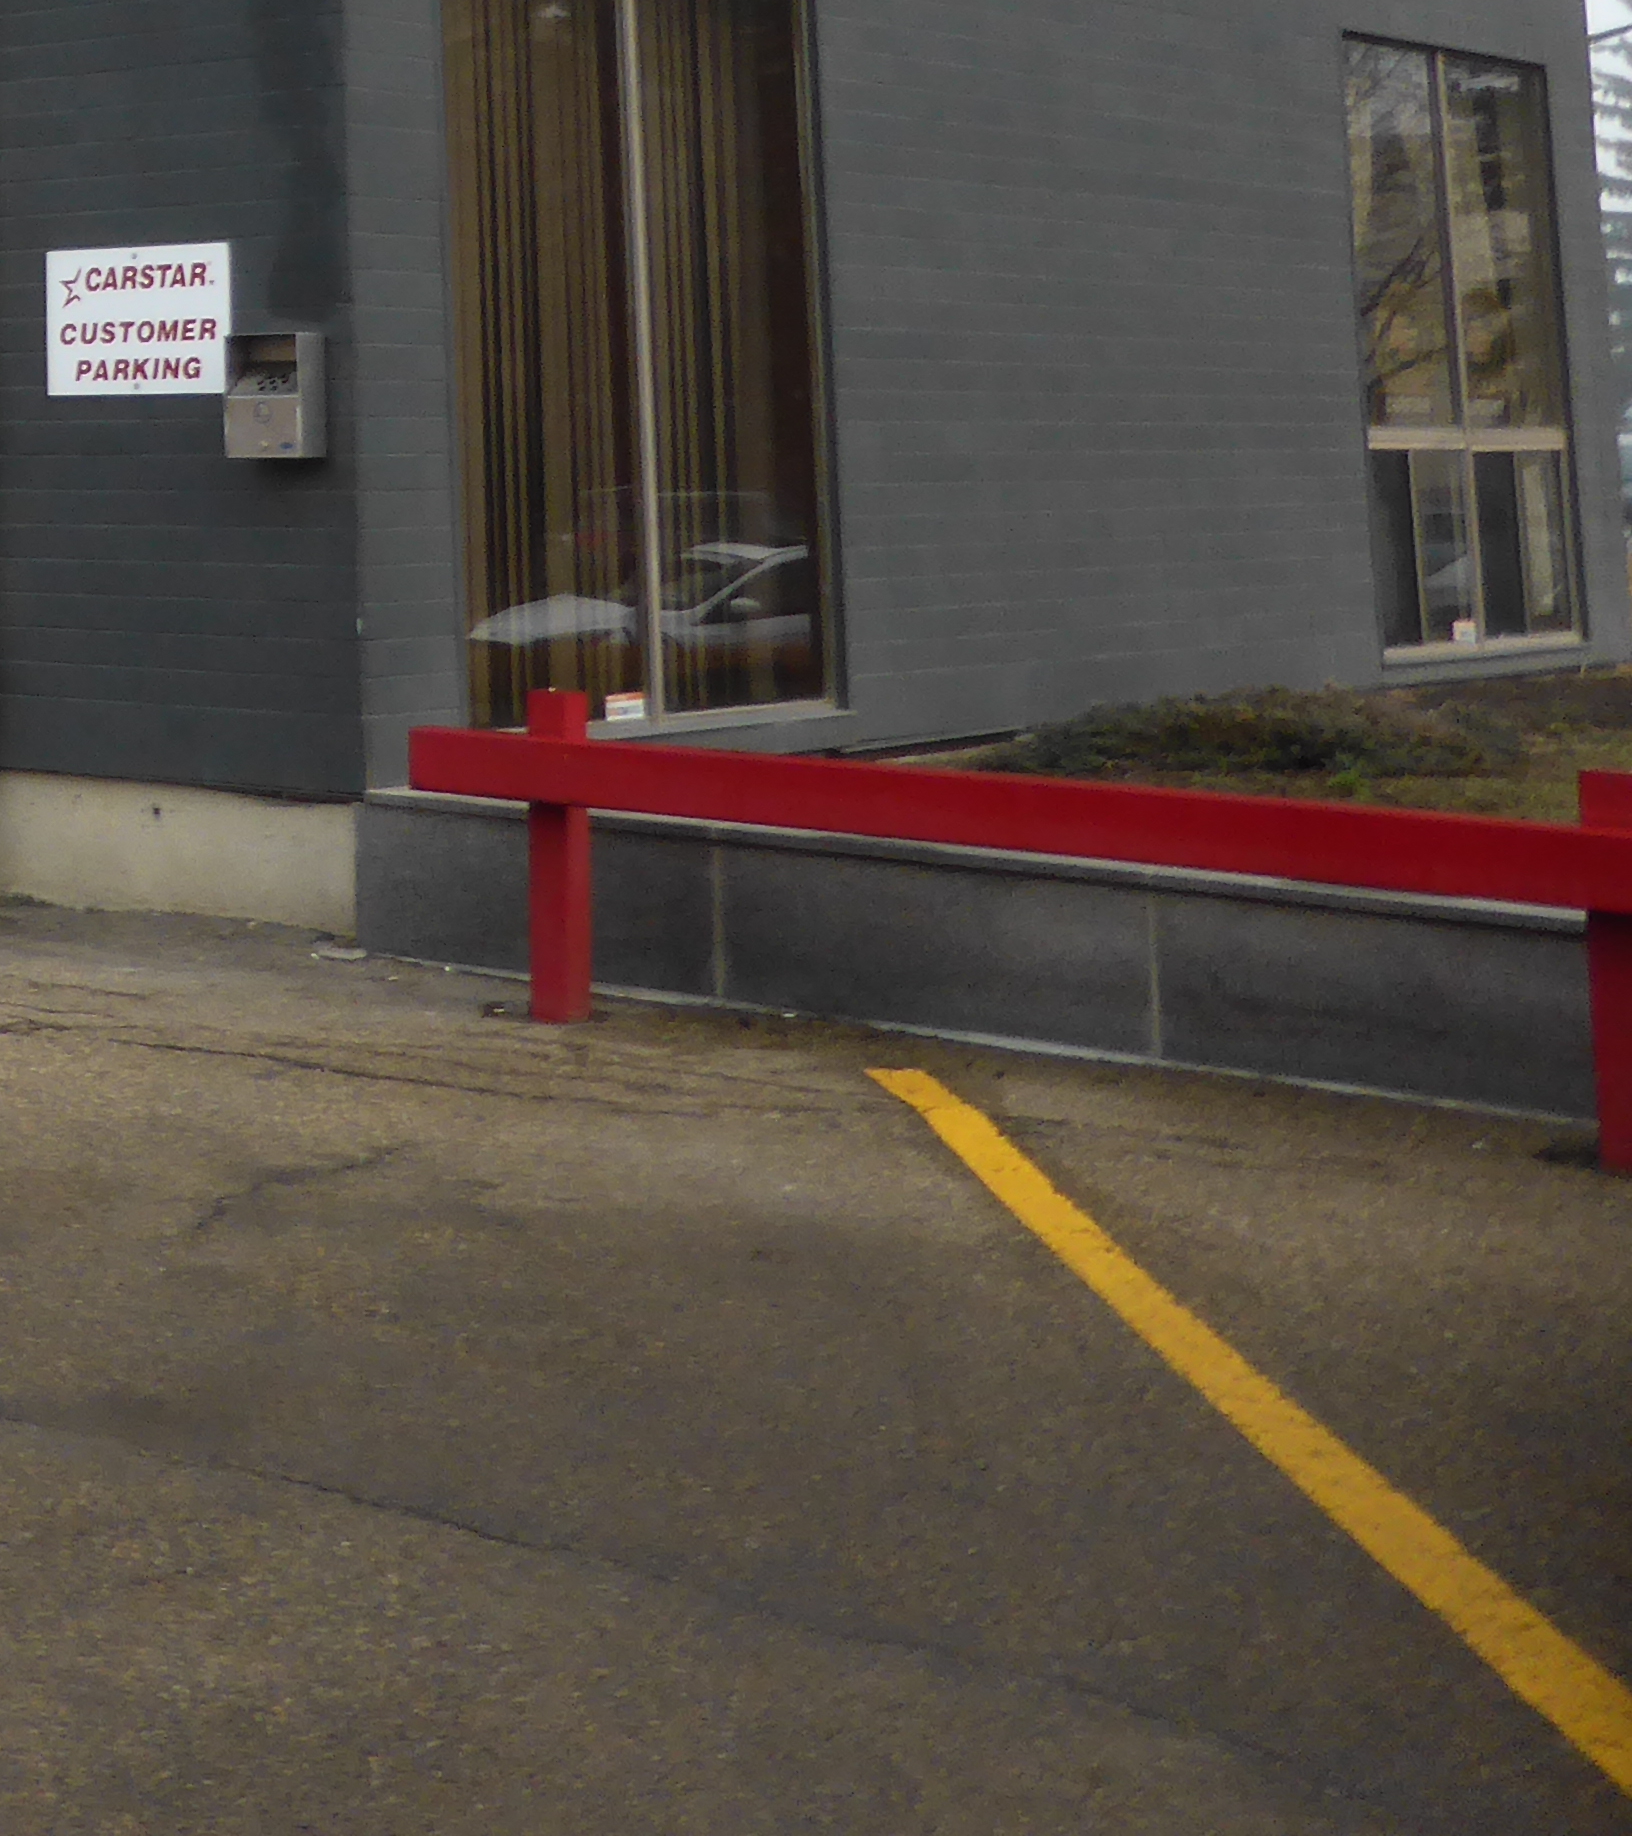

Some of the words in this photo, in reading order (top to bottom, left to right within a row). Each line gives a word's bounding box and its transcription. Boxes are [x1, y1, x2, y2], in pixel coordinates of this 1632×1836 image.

[86, 262, 207, 292] CARSTAR
[59, 318, 217, 345] CUSTOMER
[75, 357, 202, 381] PARKING
